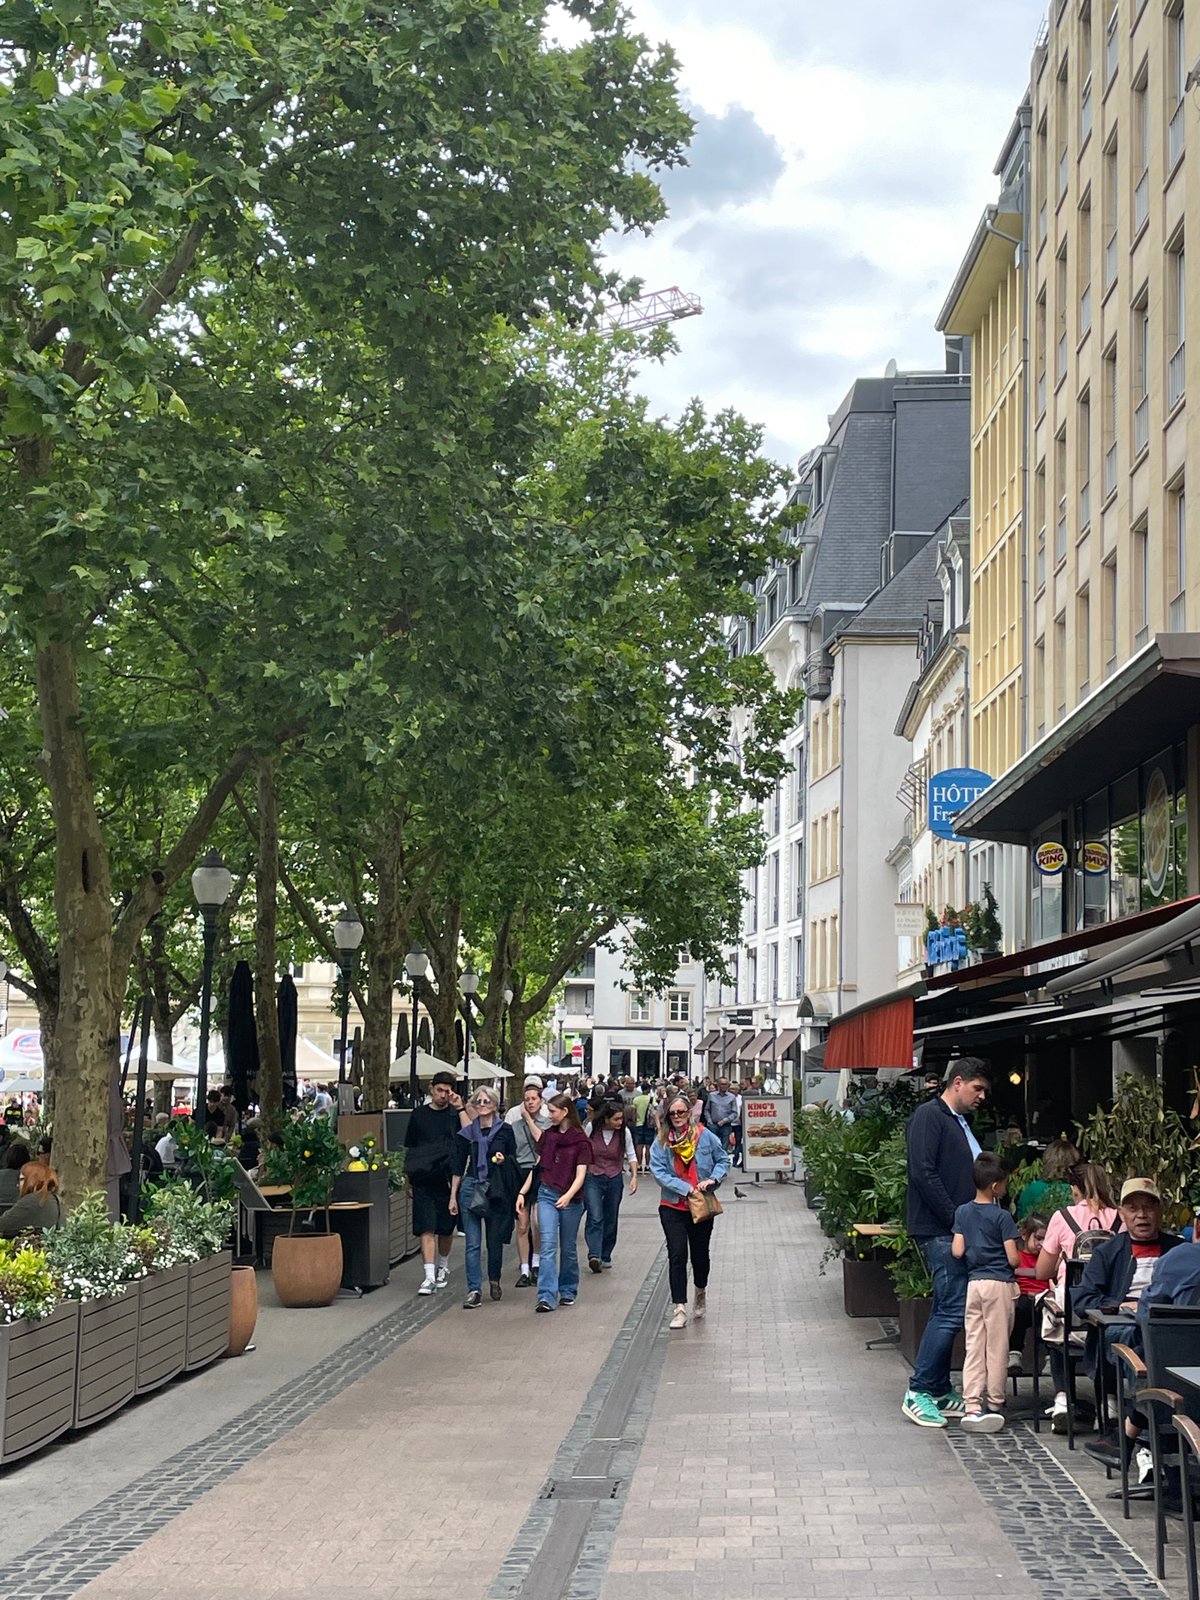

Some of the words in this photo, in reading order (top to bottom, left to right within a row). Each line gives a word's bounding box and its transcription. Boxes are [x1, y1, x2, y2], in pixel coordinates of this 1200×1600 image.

[933, 783, 987, 803] HÔTE
[1038, 848, 1063, 859] BURGER
[1039, 853, 1064, 866] KING
[747, 1102, 775, 1110] KING'S
[747, 1110, 777, 1118] CHOICE
